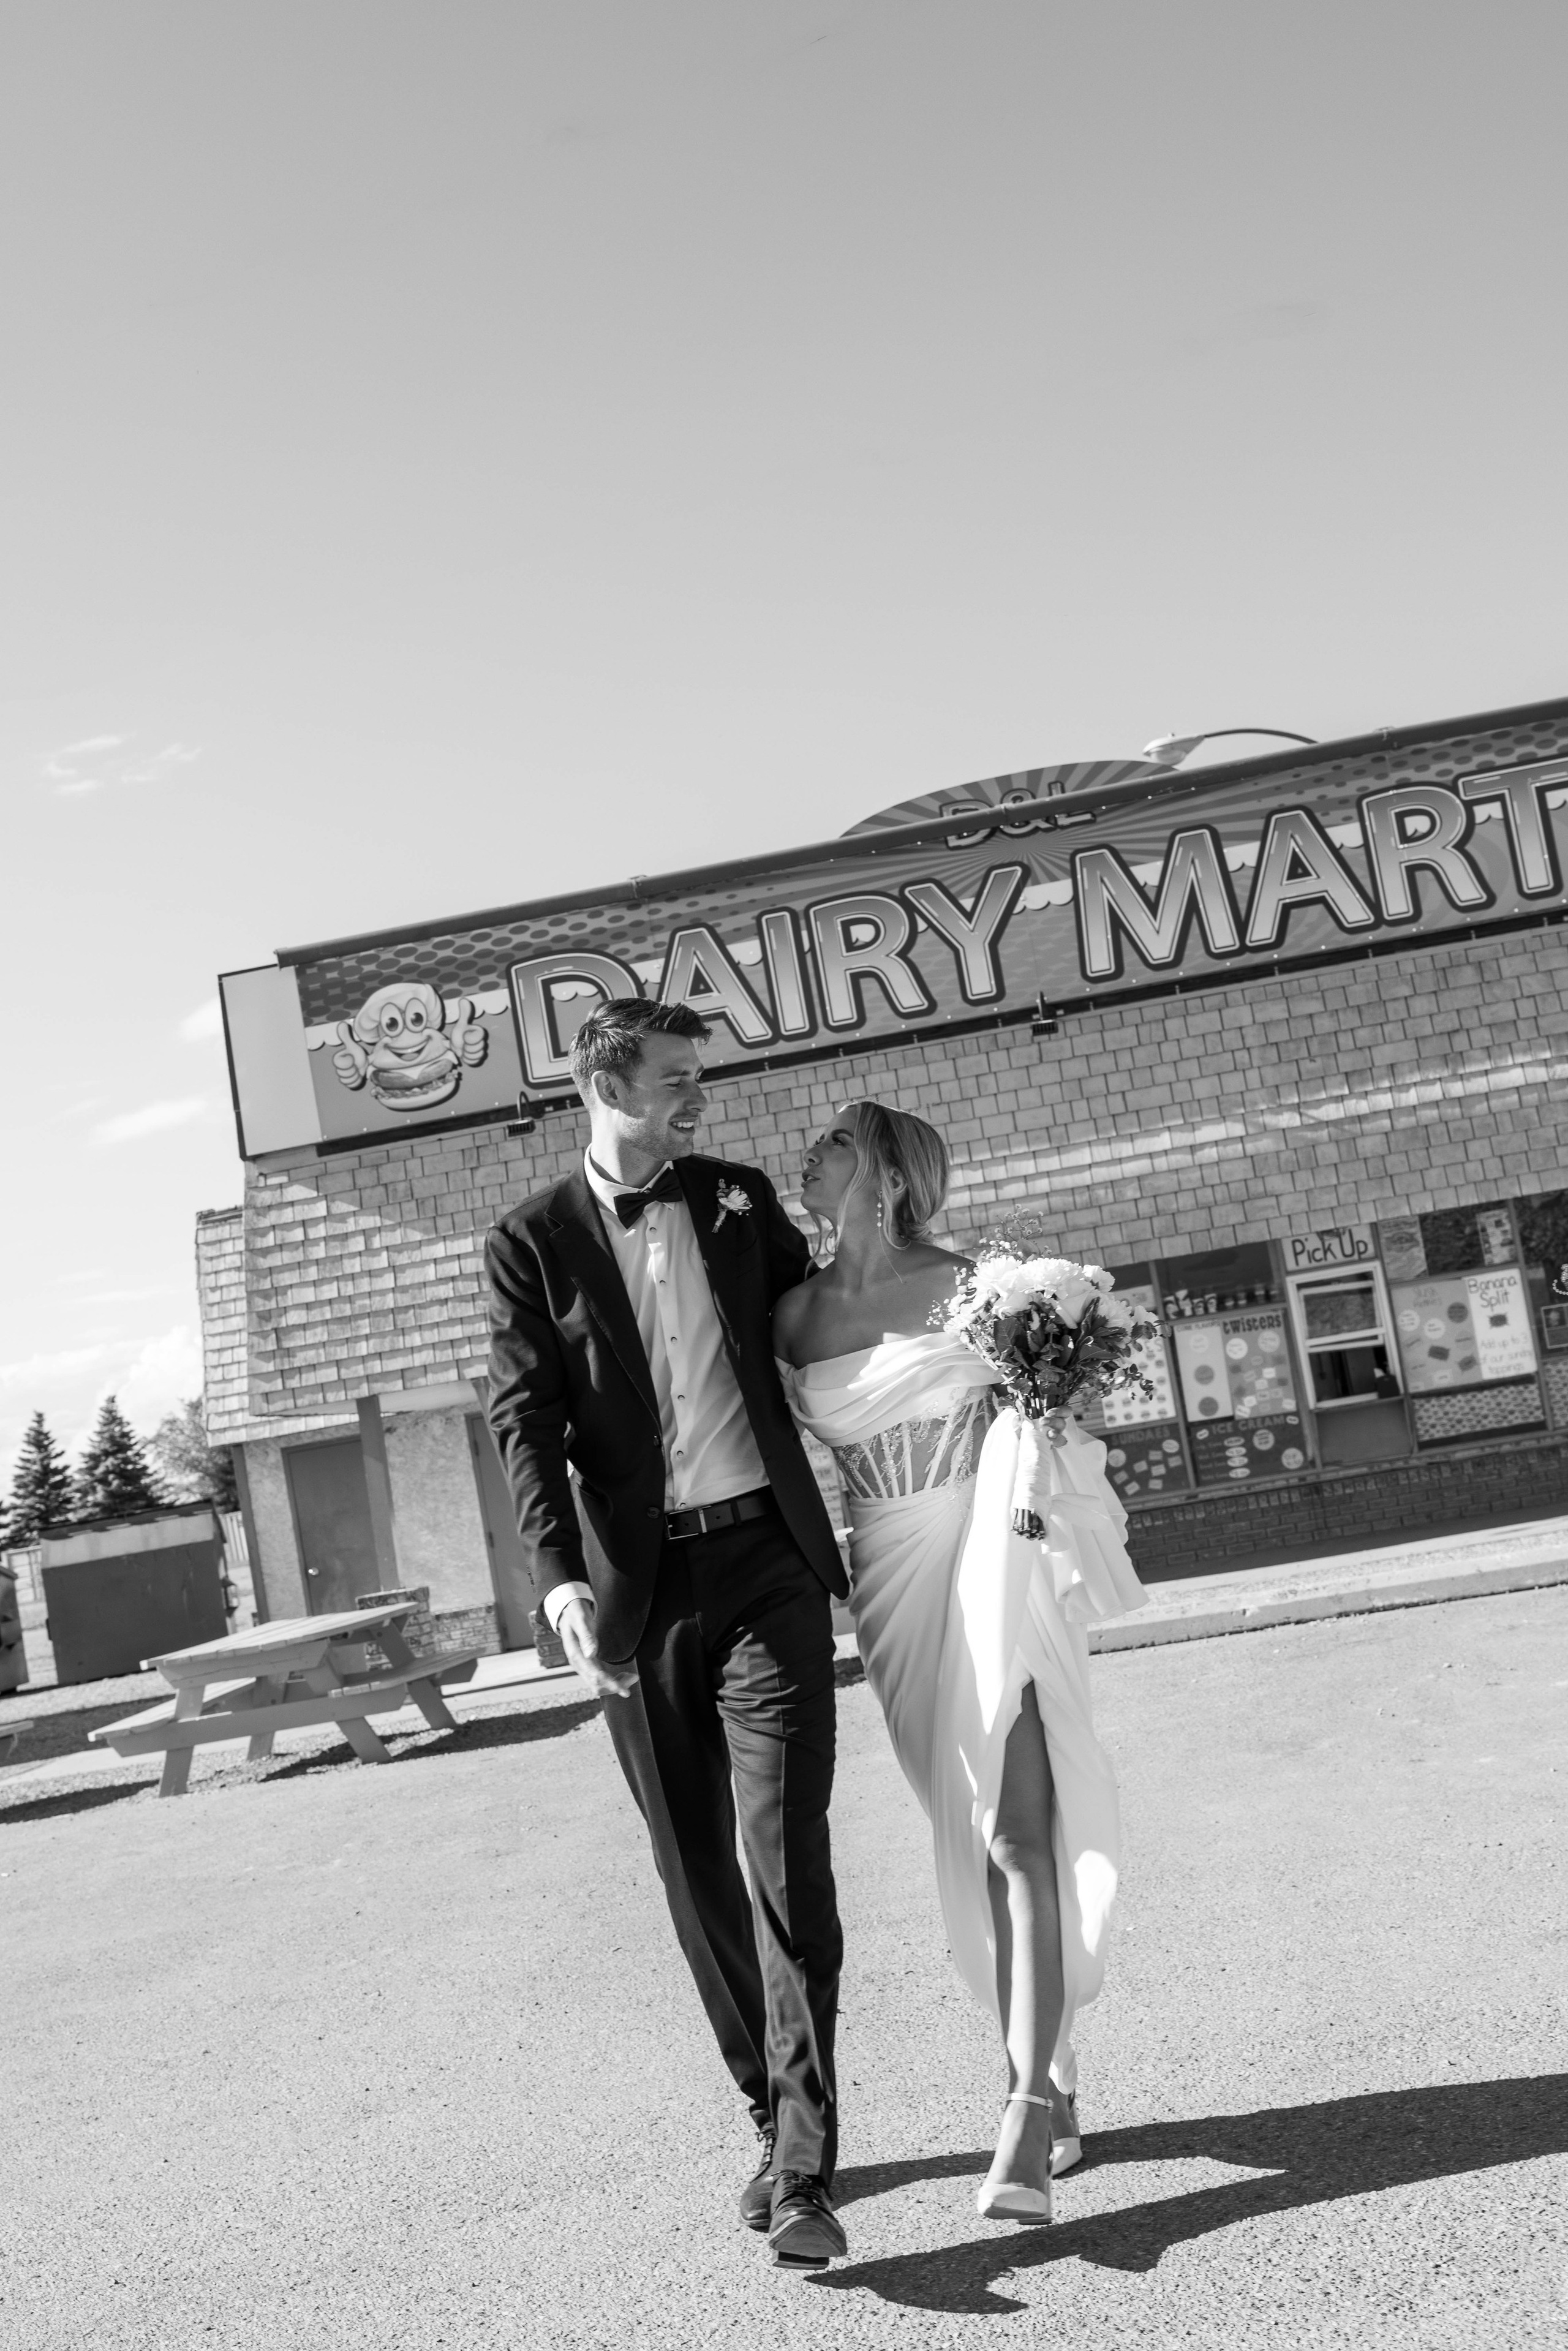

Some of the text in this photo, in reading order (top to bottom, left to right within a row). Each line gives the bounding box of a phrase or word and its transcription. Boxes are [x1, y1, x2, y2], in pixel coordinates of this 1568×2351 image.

[509, 755, 1567, 1086] DAIRY MART
[1291, 1237, 1337, 1267] Pick
[1338, 1228, 1368, 1260] Up
[1468, 1275, 1518, 1294] Banana
[1479, 1289, 1510, 1311] Split
[1211, 1421, 1234, 1435] ICE
[1238, 1414, 1286, 1431] CREAM
[1111, 1425, 1170, 1446] SUNDAES
